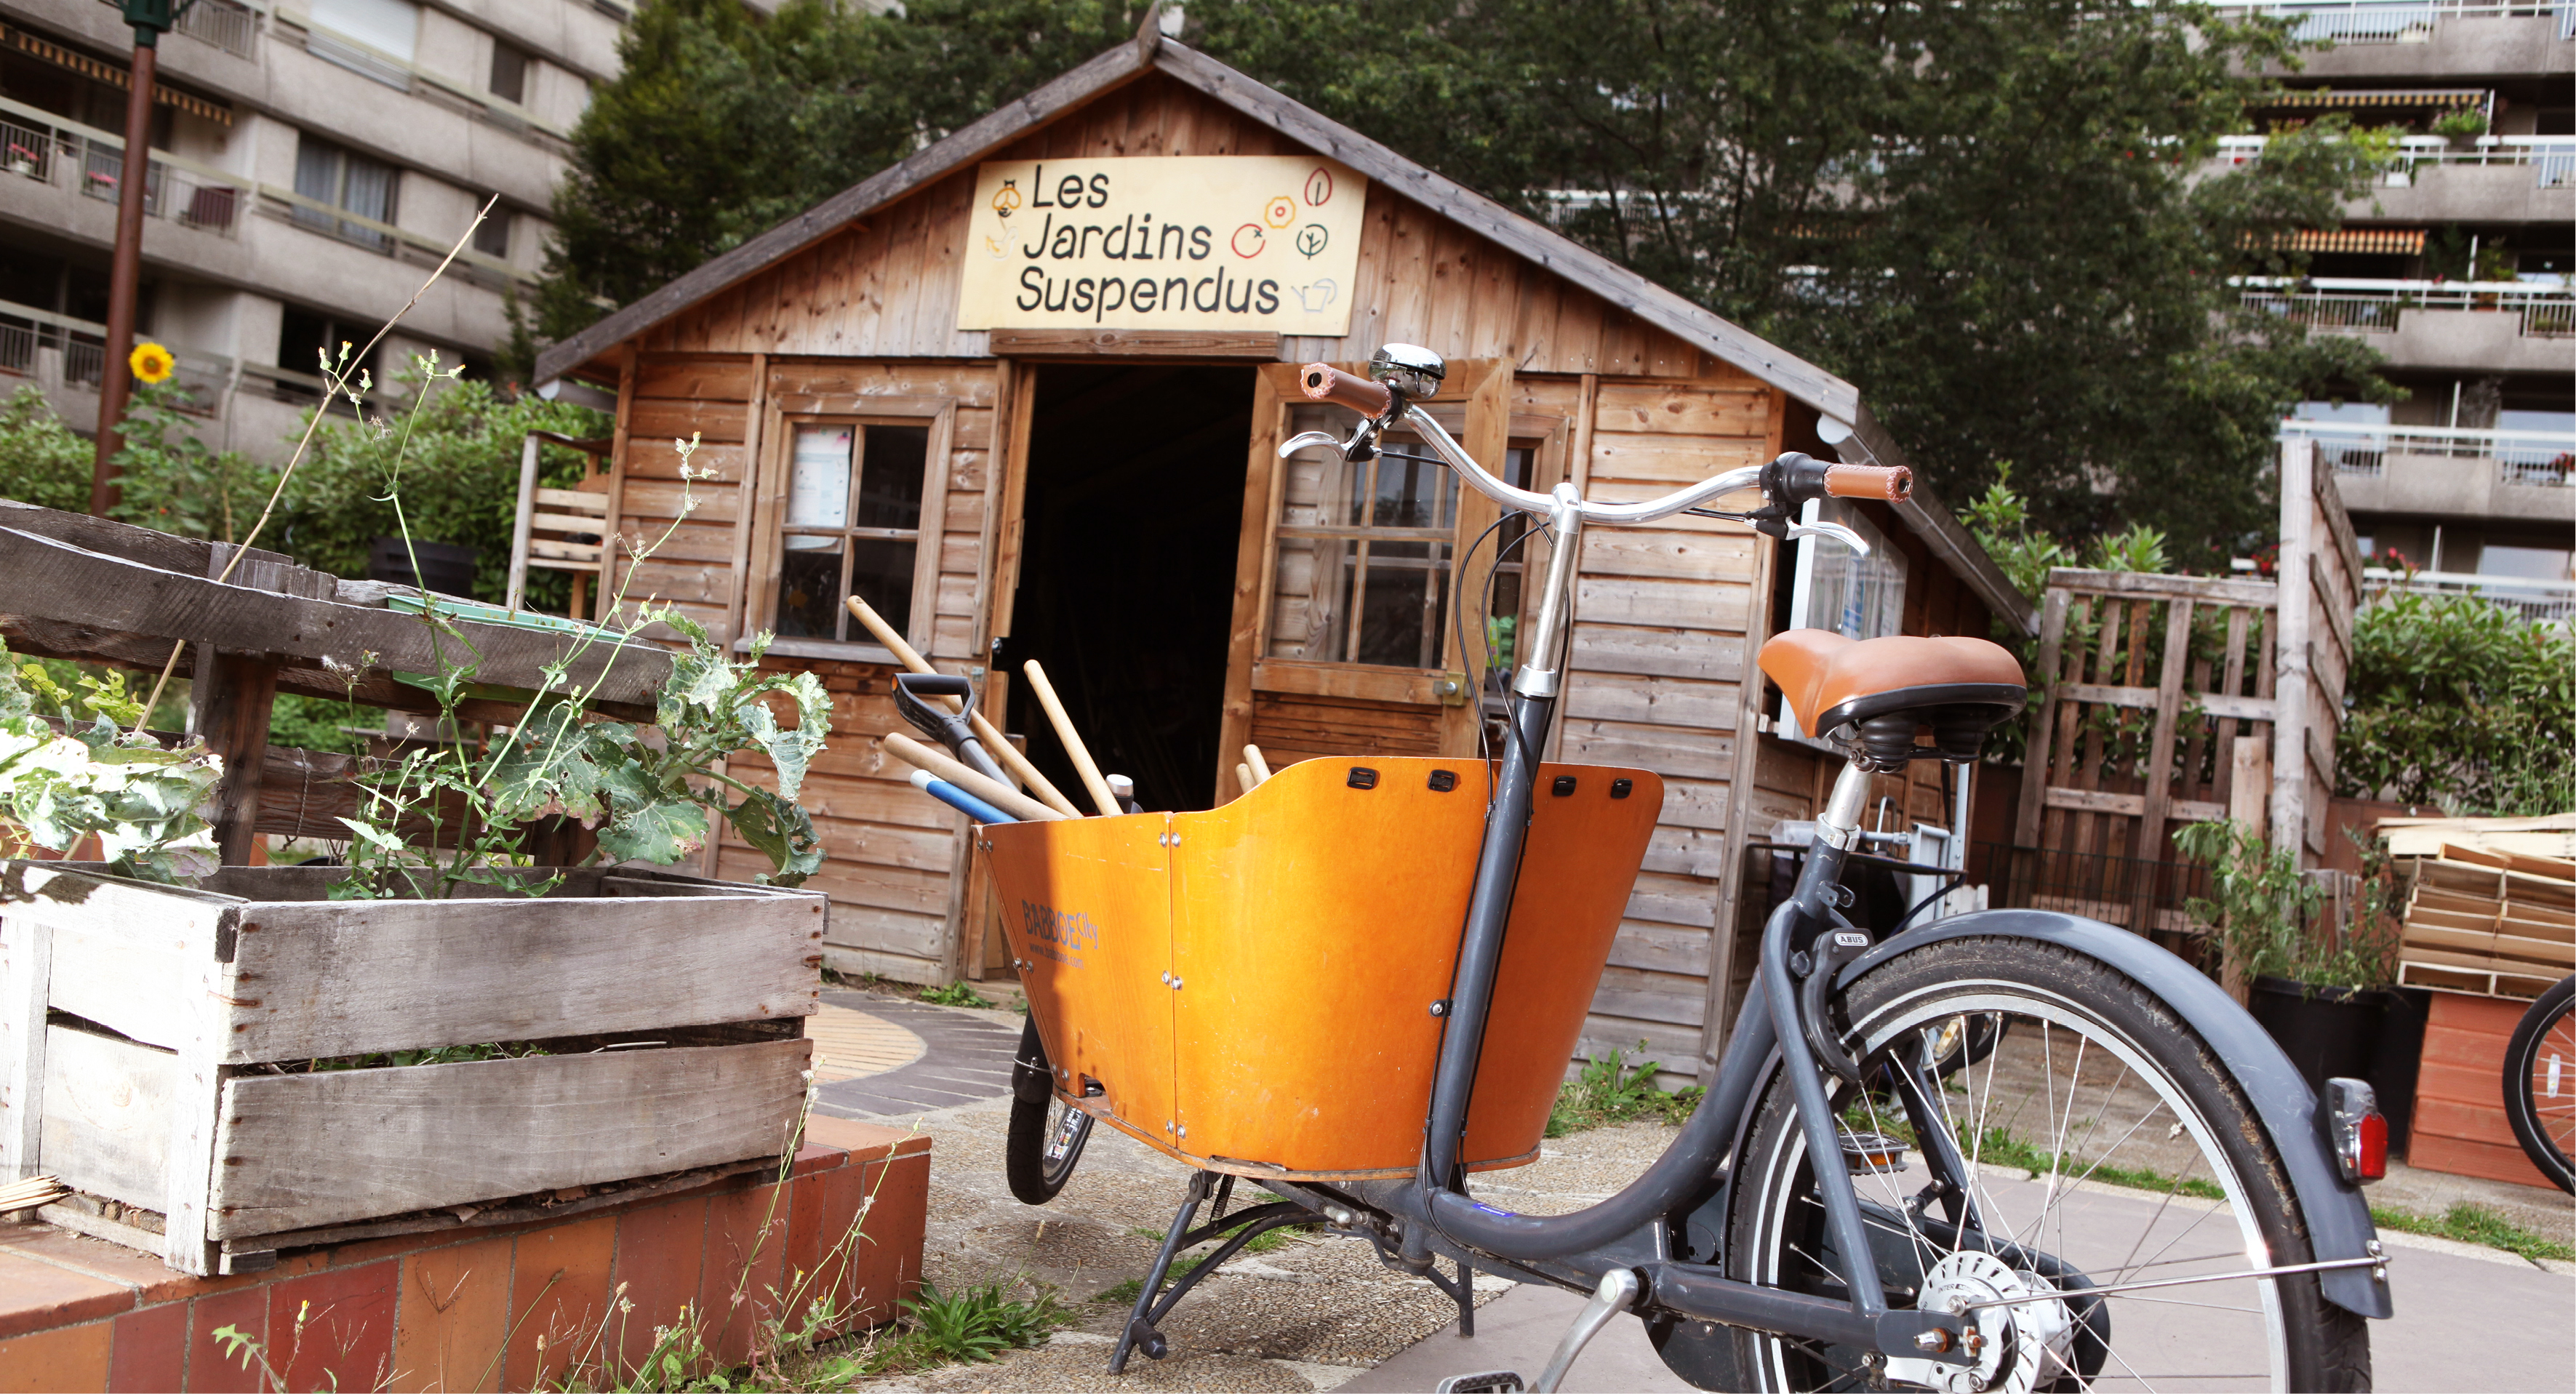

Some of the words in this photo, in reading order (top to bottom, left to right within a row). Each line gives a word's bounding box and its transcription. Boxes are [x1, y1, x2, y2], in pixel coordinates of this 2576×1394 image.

[1032, 164, 1109, 209] Les
[1023, 213, 1212, 260] Jardins
[1016, 265, 1279, 323] Suspendus
[1022, 899, 1081, 951] BABBOE
[1076, 912, 1099, 950] City
[1028, 942, 1084, 970] www.babboe.com
